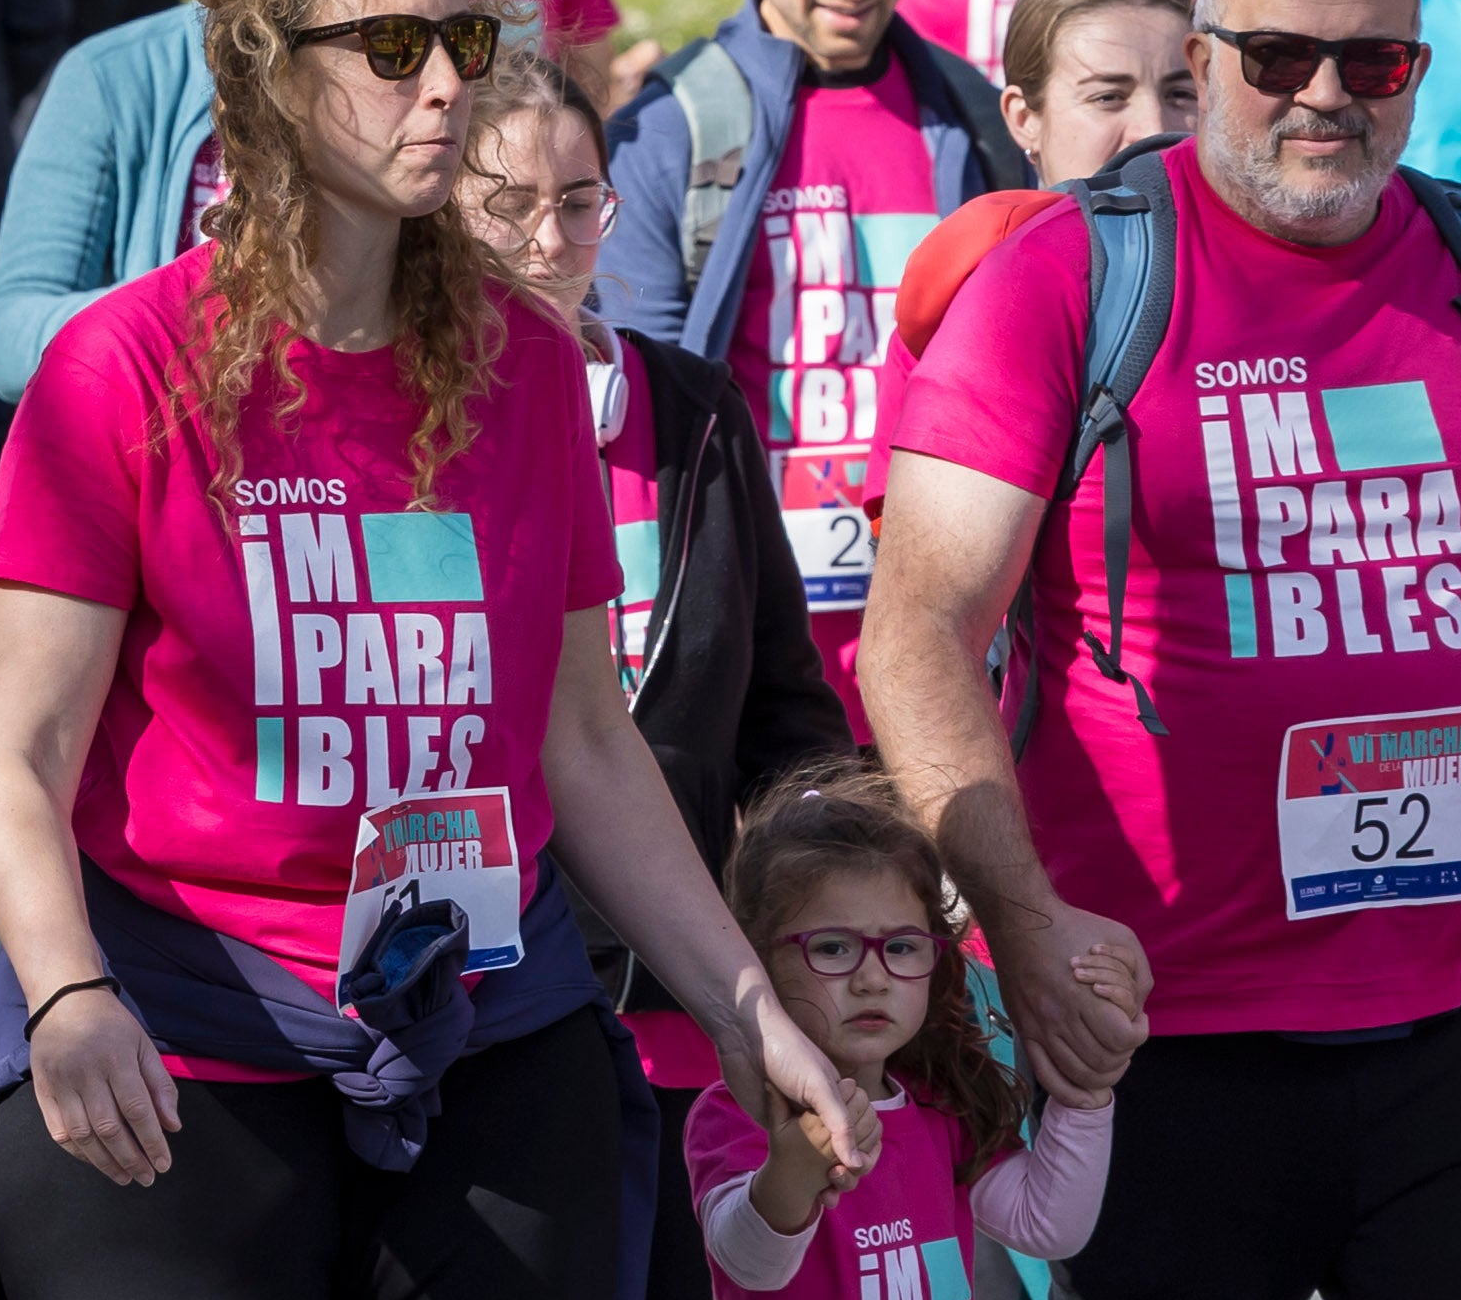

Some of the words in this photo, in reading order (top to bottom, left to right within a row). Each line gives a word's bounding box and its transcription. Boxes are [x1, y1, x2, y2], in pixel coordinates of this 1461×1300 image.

[764, 185, 847, 211] SOMOS
[1196, 356, 1308, 390] SOMOS
[235, 477, 347, 506] SOMOS
[292, 612, 492, 705] PARA
[1349, 734, 1374, 764] VI
[1351, 792, 1435, 863] 52
[855, 1218, 913, 1249] SOMOS
